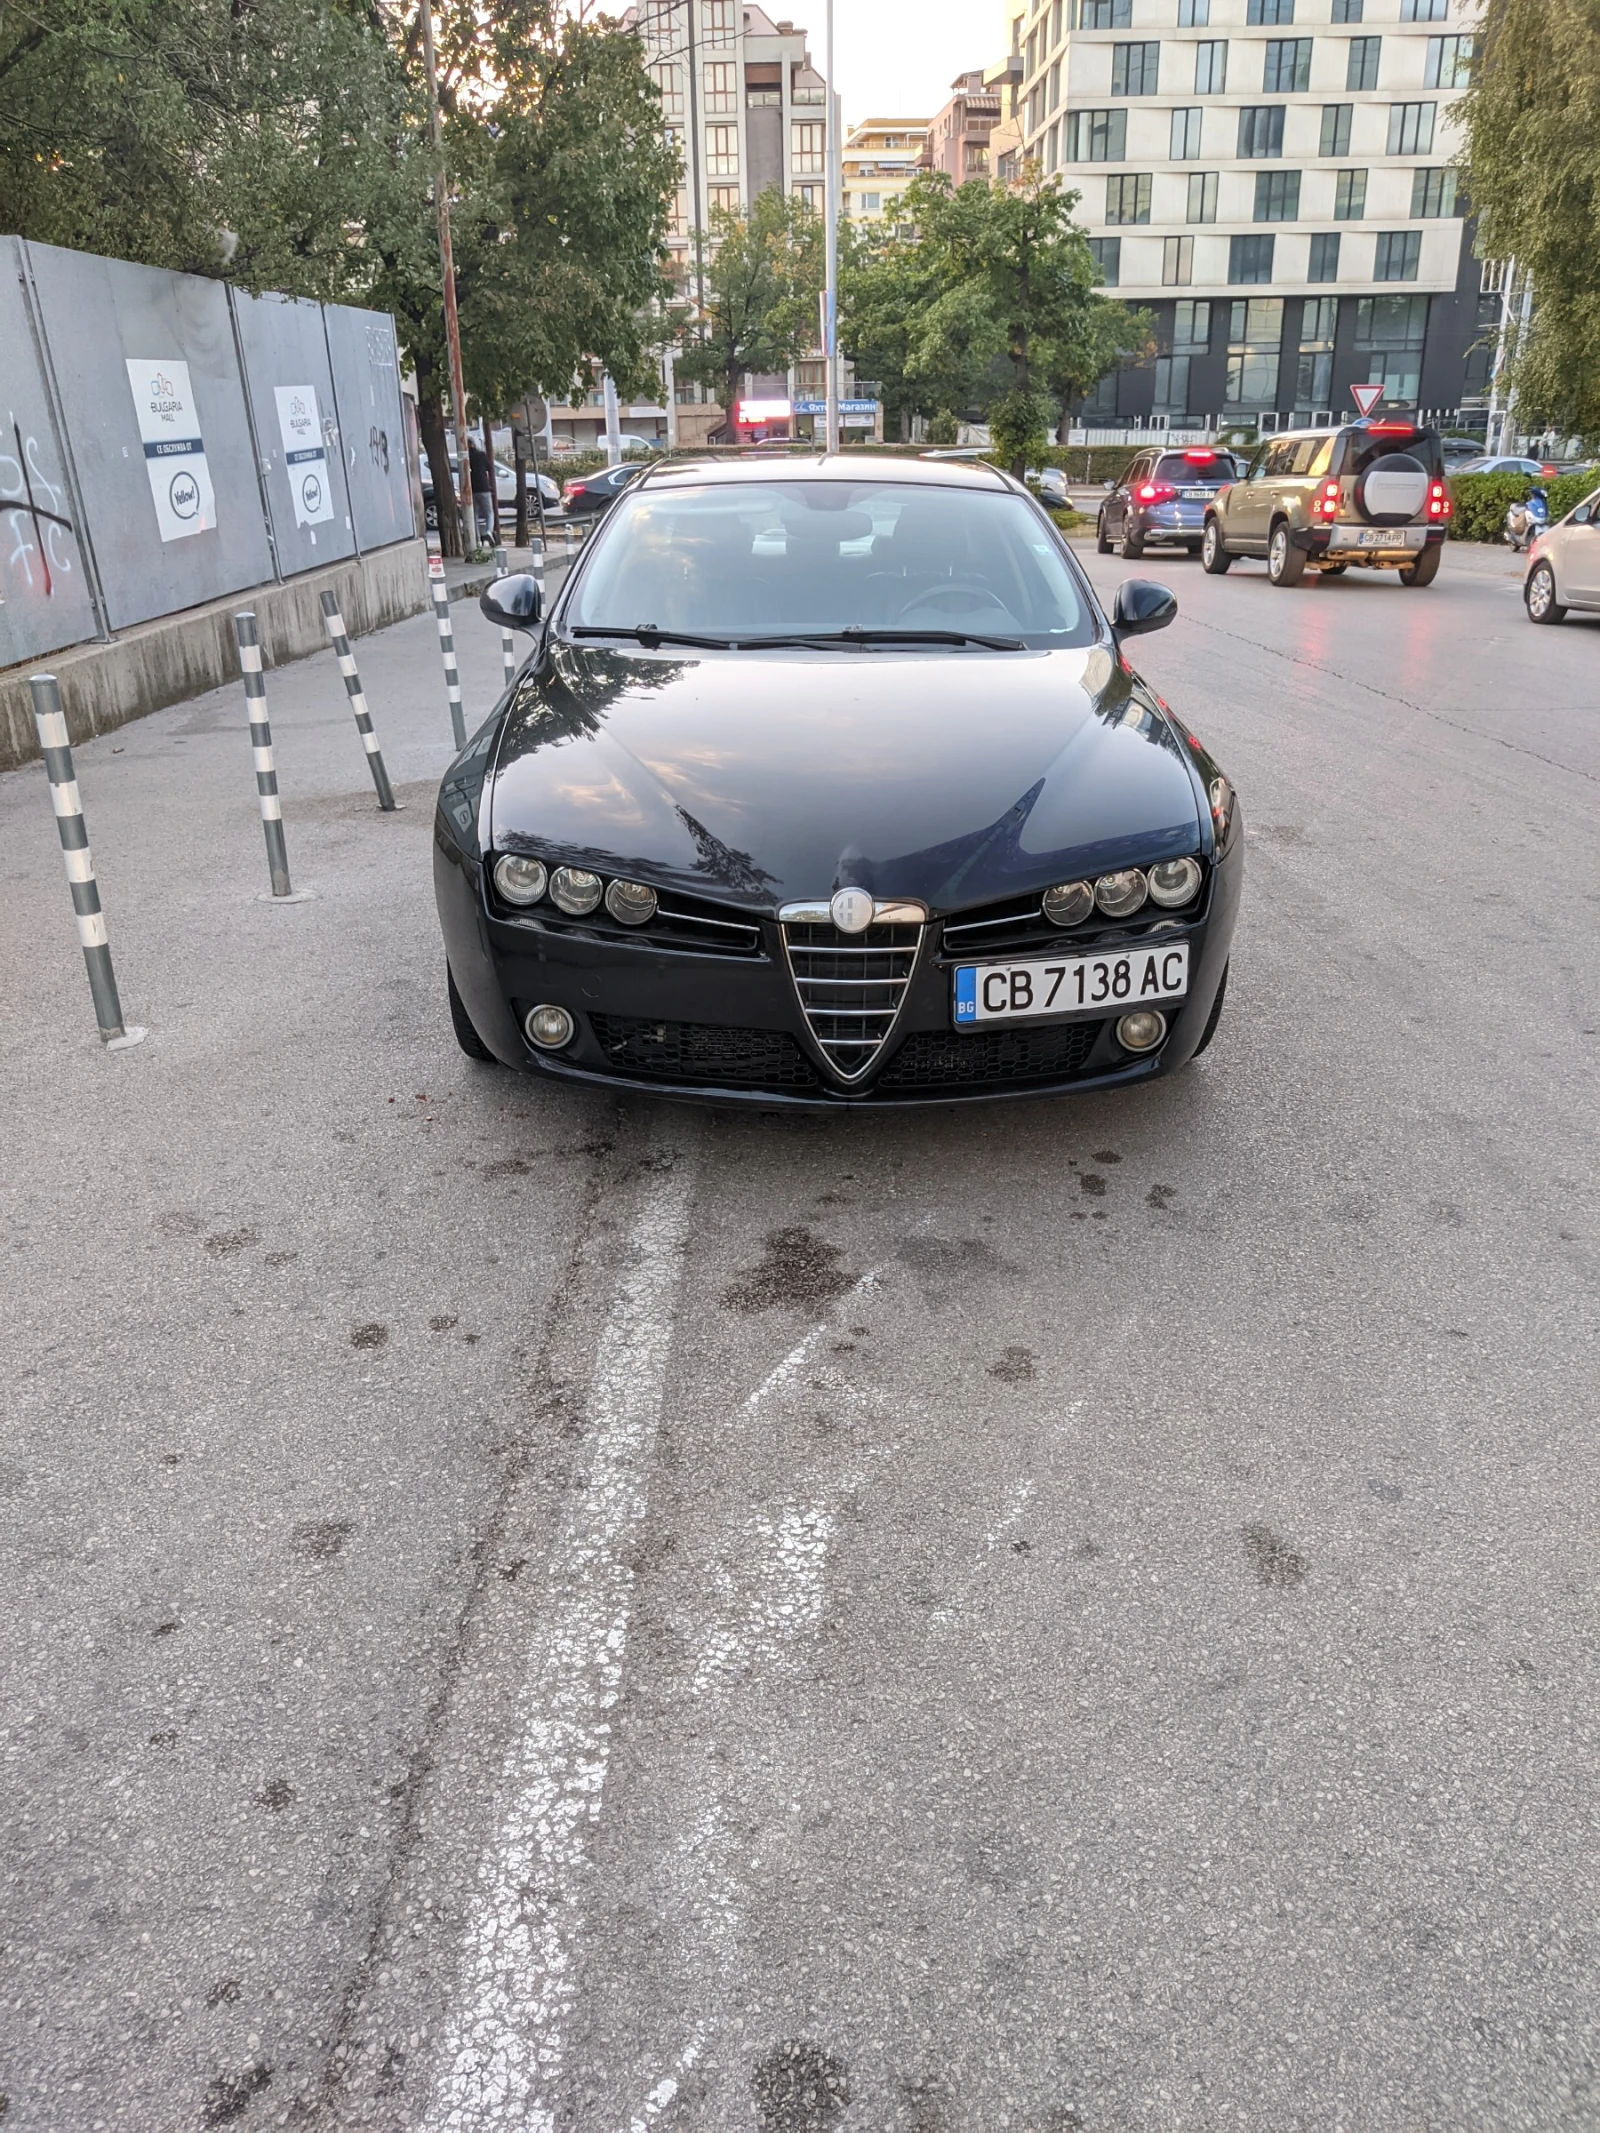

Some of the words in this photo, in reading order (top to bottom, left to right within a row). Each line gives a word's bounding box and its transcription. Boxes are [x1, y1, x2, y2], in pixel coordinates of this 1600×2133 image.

[150, 401, 183, 413] BULGARIA
[838, 402, 876, 411] Магазин
[160, 413, 175, 422] MALL
[174, 485, 196, 506] Yellow!
[983, 970, 1033, 1012] CB
[1044, 960, 1131, 1008] 7138
[1140, 952, 1183, 995] AC
[958, 1001, 975, 1014] BG
